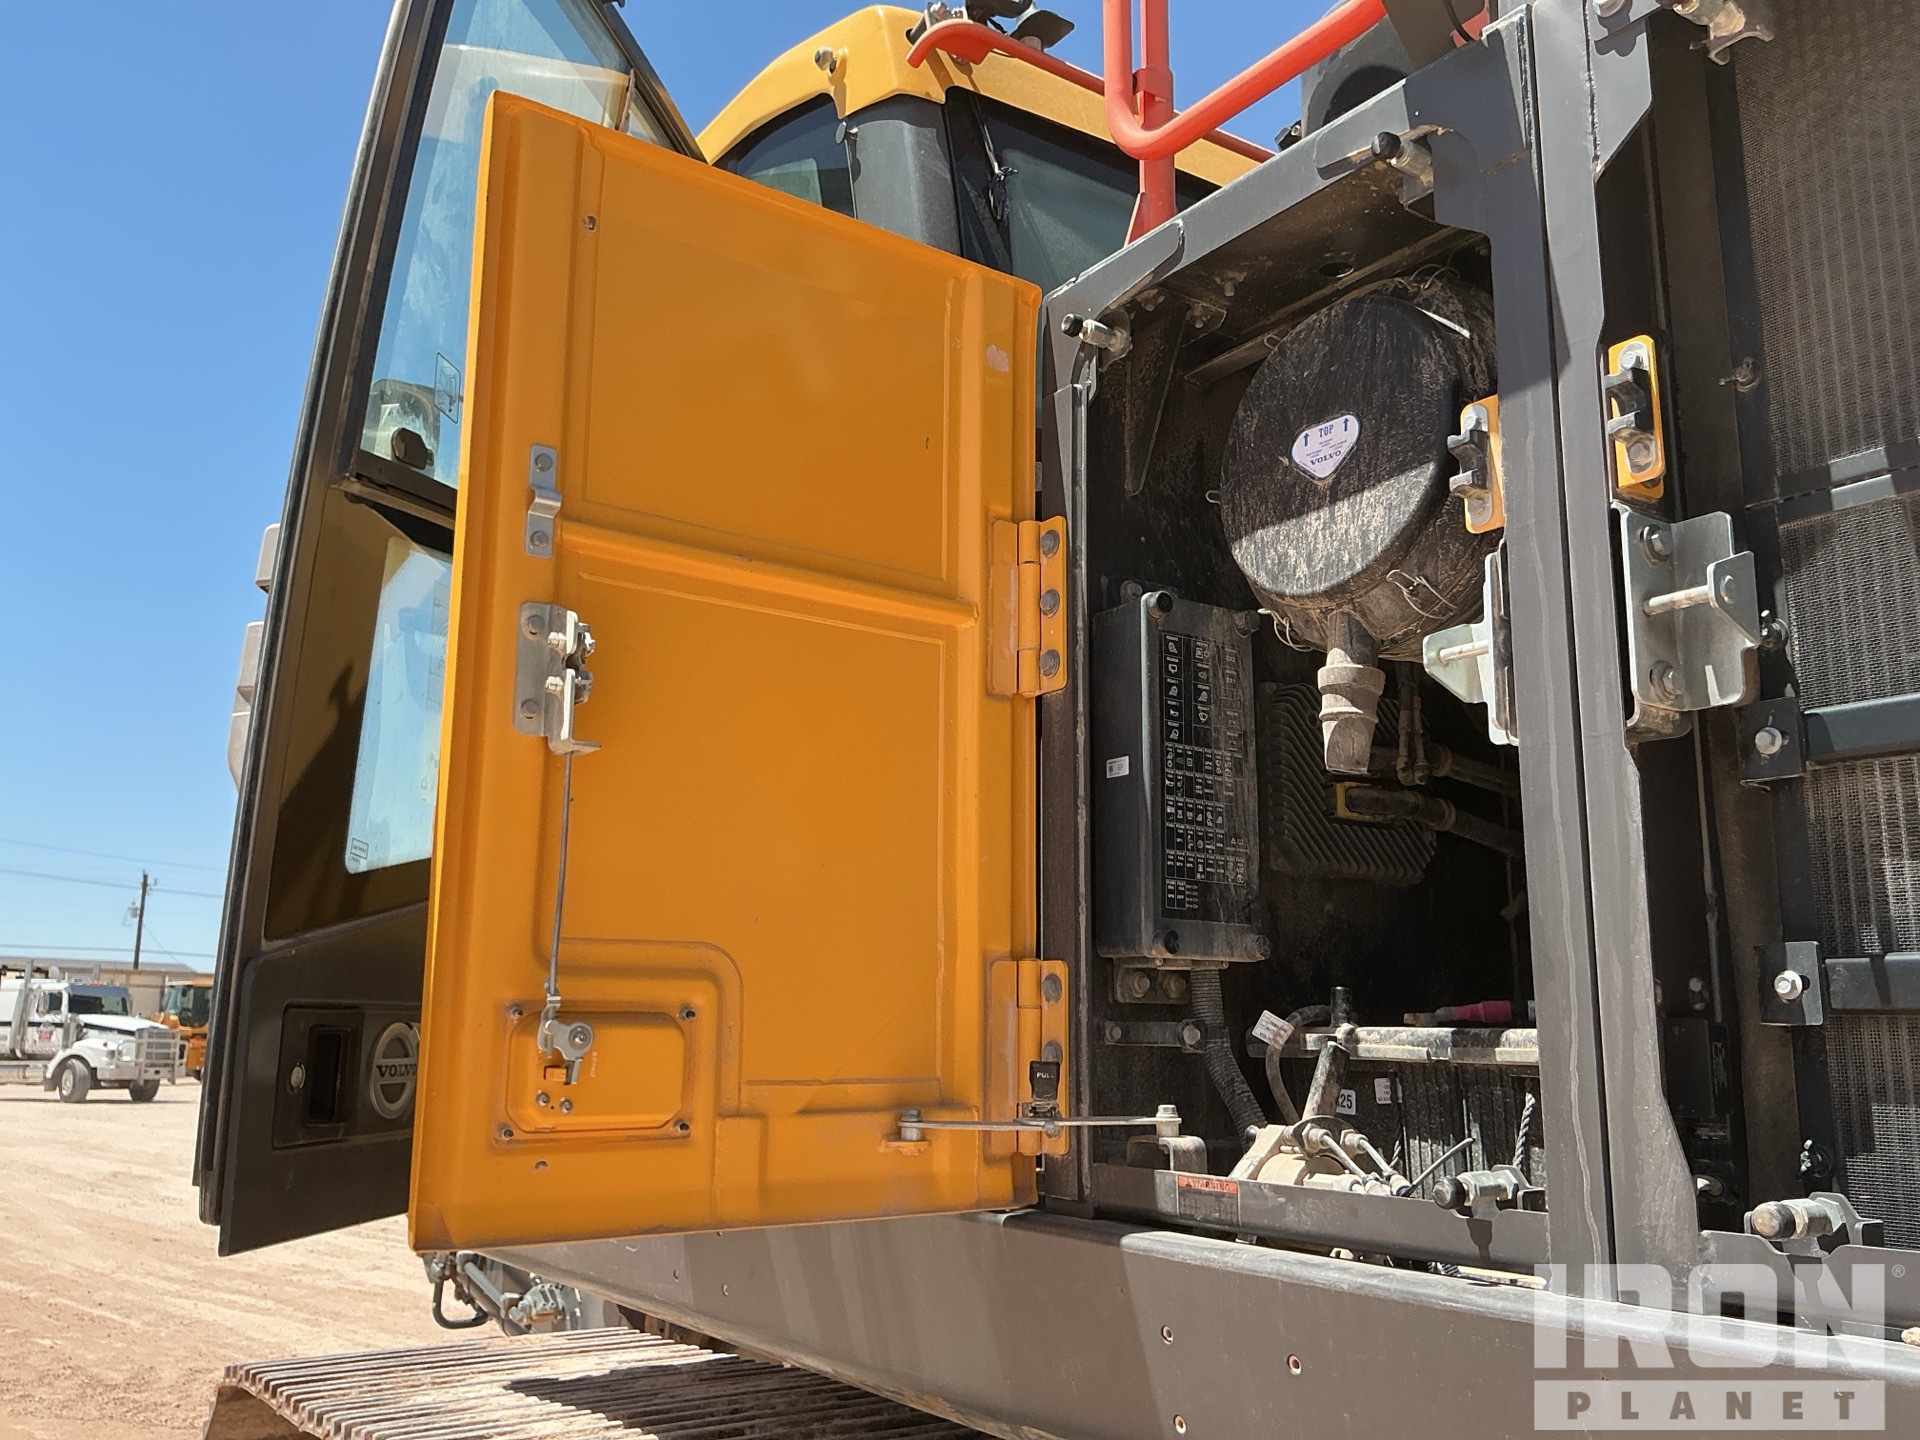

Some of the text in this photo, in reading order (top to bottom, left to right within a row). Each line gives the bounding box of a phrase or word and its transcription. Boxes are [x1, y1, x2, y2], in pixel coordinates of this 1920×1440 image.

[1318, 424, 1334, 438] TOP
[1310, 450, 1341, 465] VOLVO
[1036, 1071, 1055, 1079] PULL
